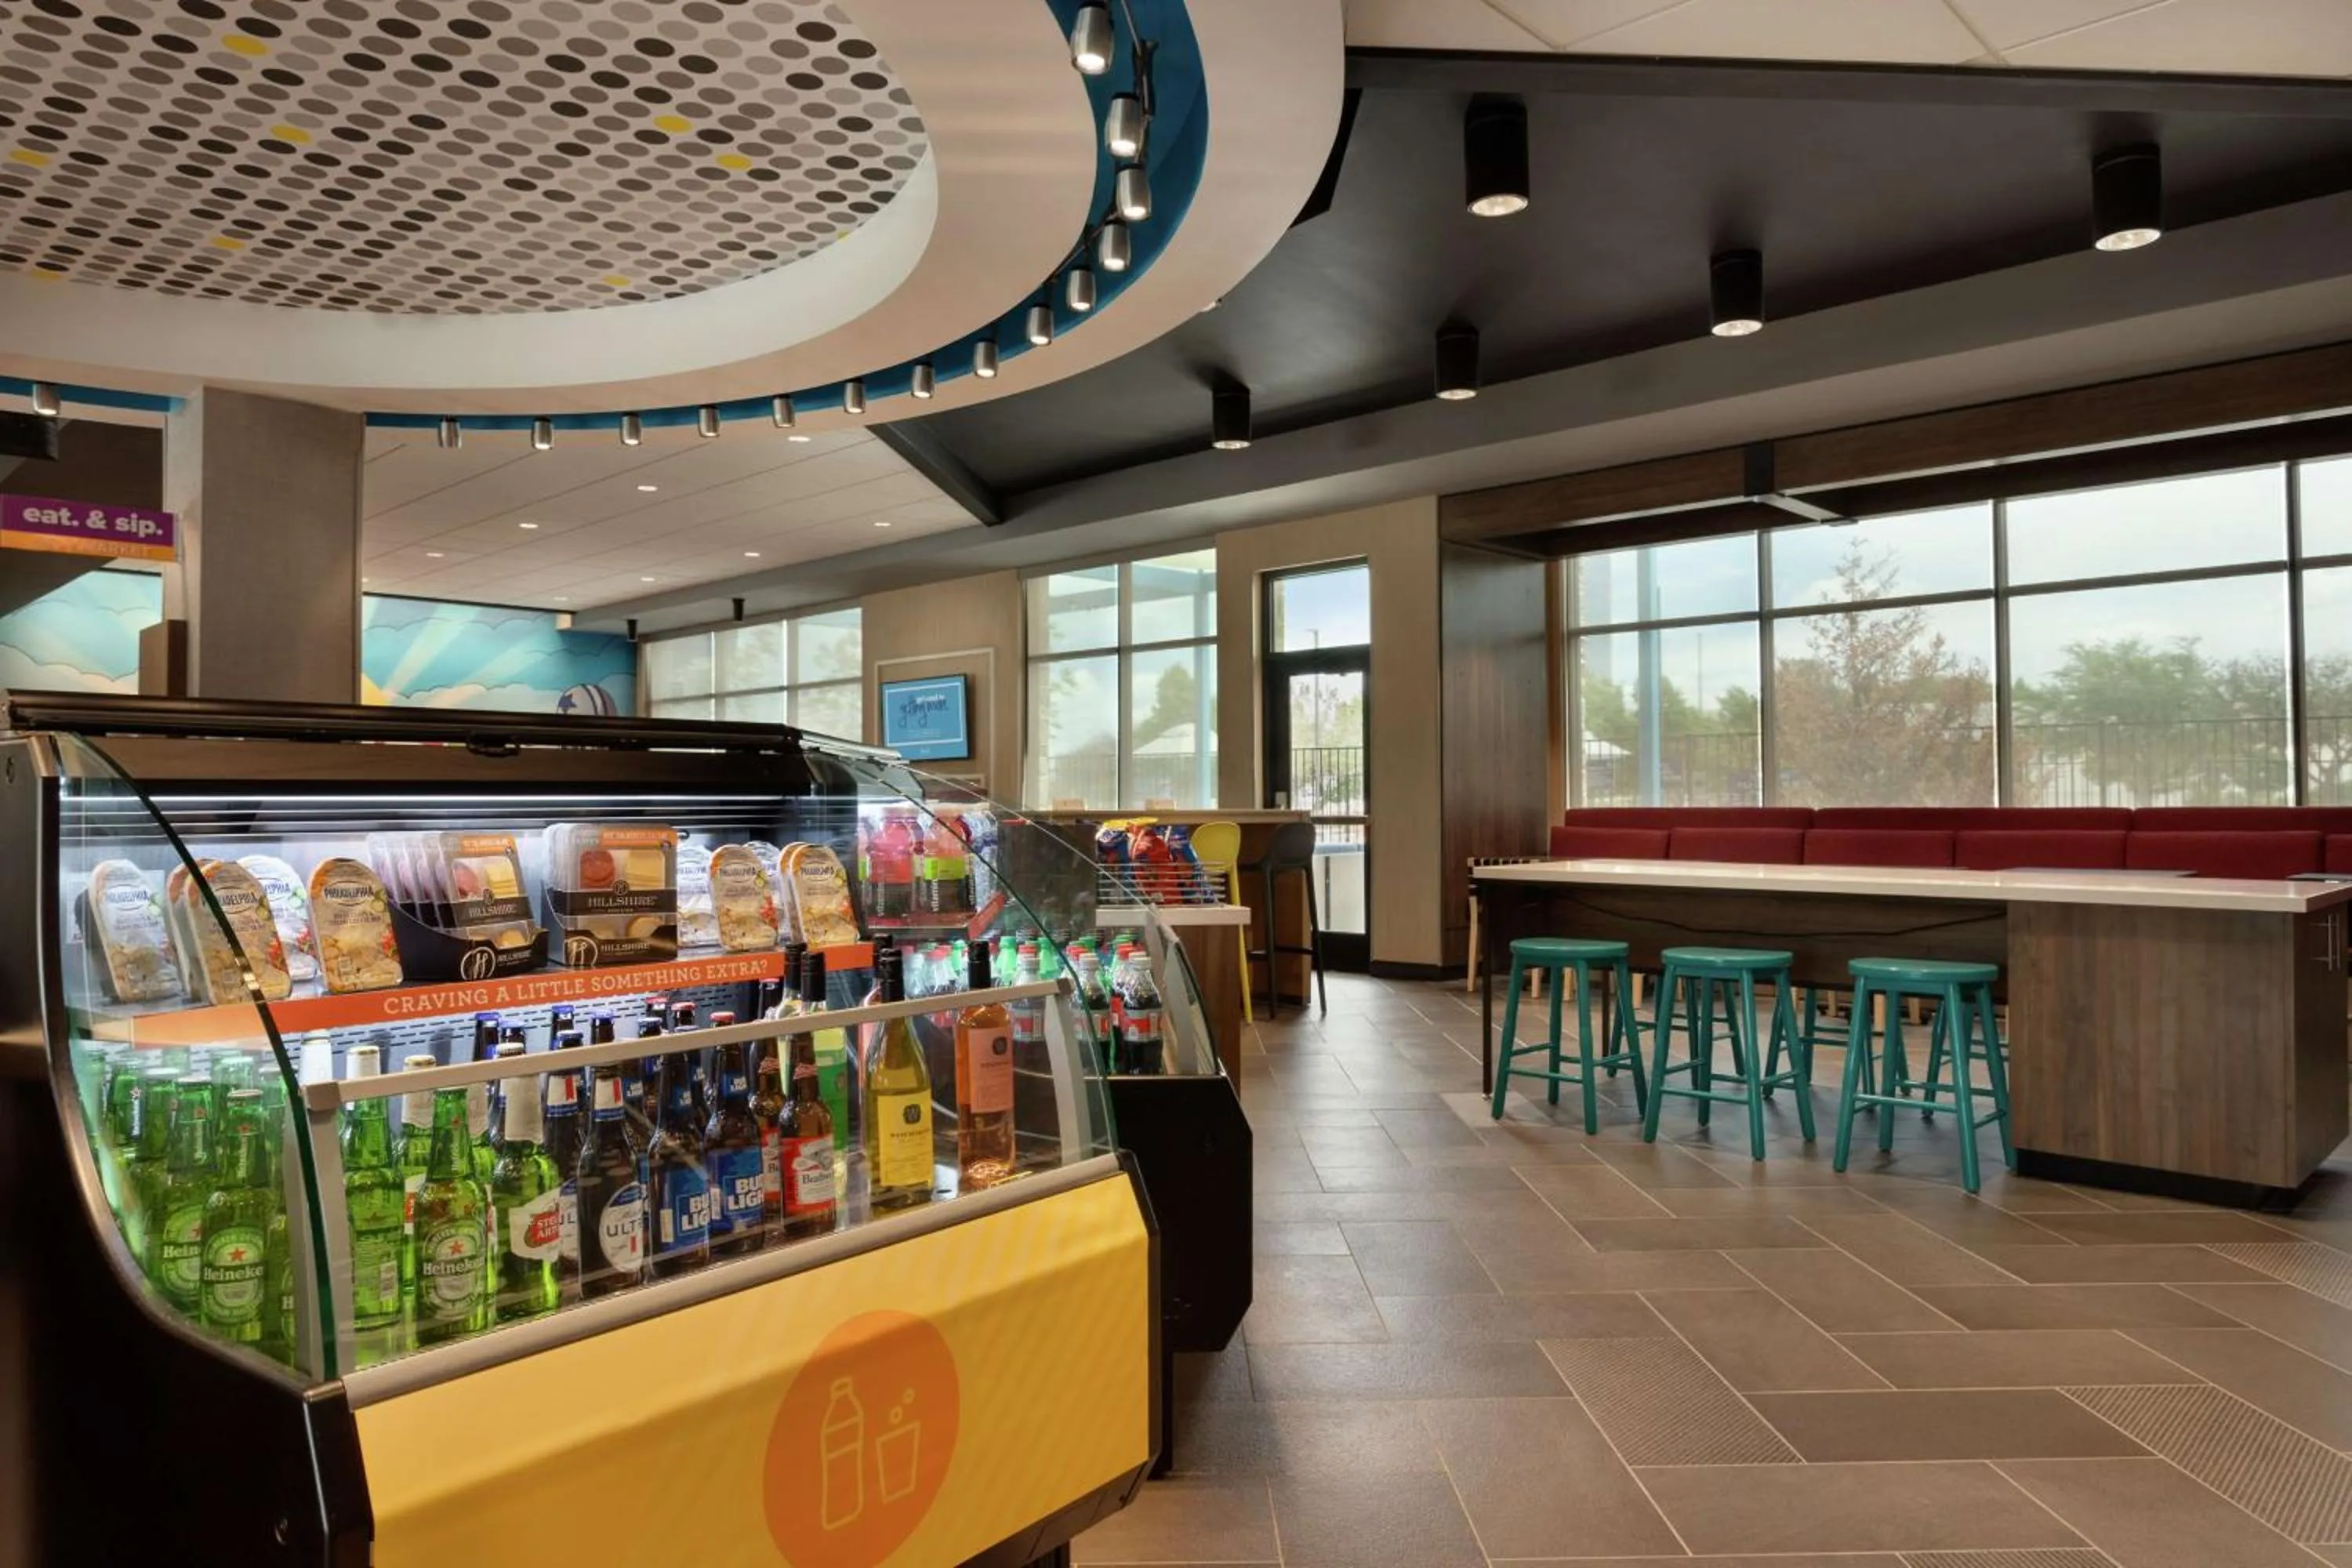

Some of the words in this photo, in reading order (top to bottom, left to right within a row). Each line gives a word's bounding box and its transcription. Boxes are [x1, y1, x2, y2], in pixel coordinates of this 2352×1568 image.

[23, 507, 79, 526] eat.
[85, 510, 107, 529] &
[115, 513, 163, 538] sip.
[589, 896, 655, 907] HILLSHIRE
[383, 989, 488, 1014] CRAVING
[495, 987, 510, 1003] A
[517, 979, 586, 1000] LITTLE
[591, 967, 700, 992] SOMETHING
[706, 959, 768, 979] EXTRA?
[735, 1174, 764, 1193] BU
[690, 1192, 710, 1213] BU
[728, 1190, 764, 1210] LIGH
[681, 1208, 710, 1231] LIG
[163, 1243, 201, 1259] Hein
[203, 1265, 264, 1281] Heineke
